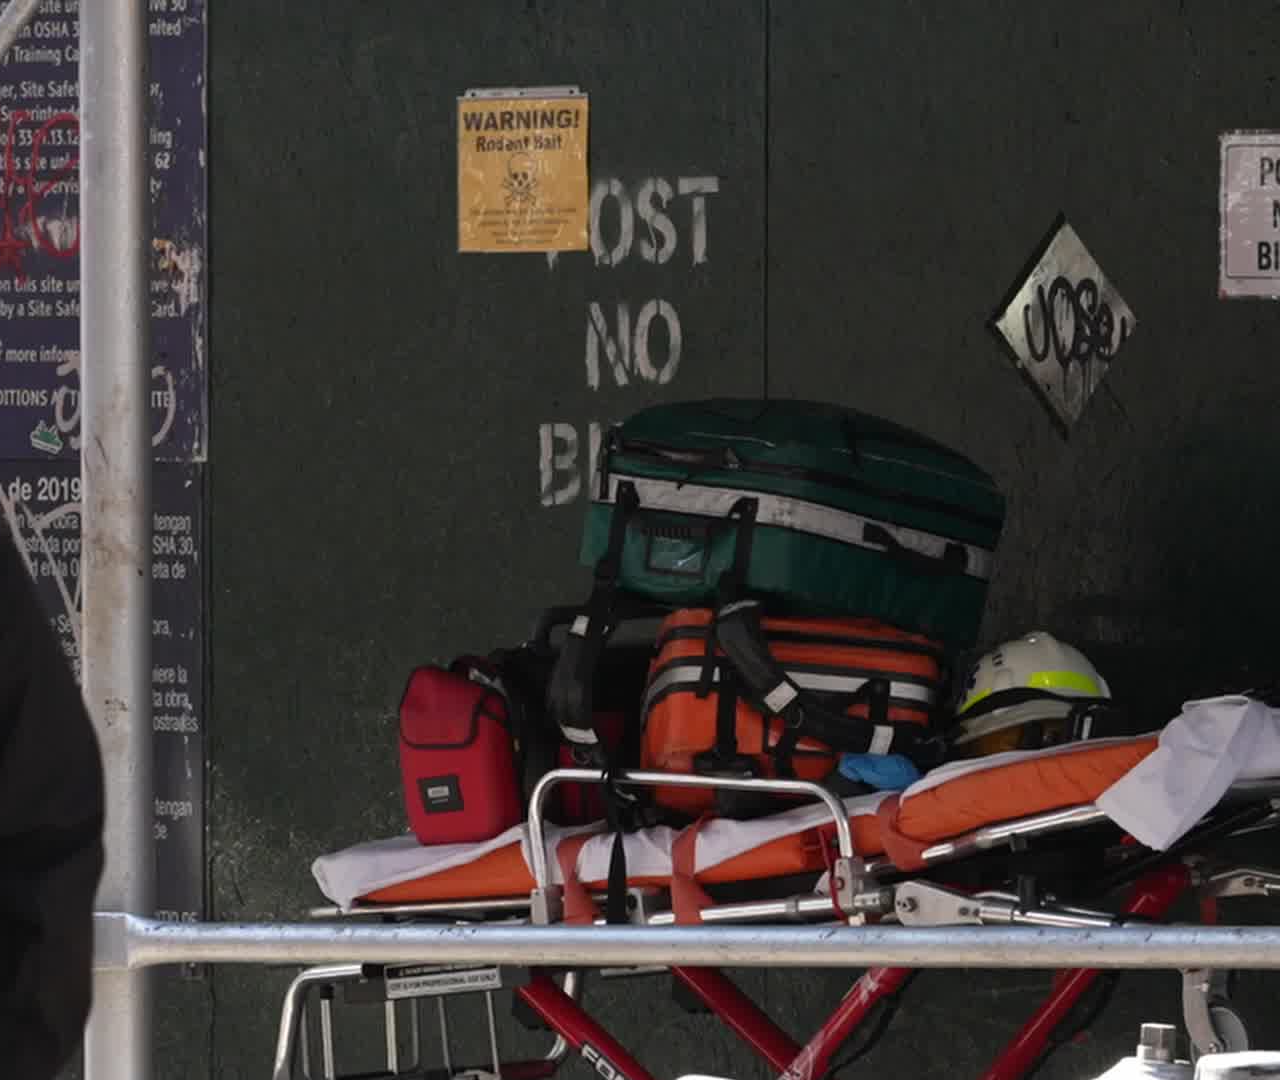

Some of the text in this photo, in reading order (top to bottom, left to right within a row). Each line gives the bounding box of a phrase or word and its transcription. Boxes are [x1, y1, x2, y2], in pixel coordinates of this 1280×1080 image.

[34, 20, 68, 38] OSHA
[14, 47, 61, 66] Training
[20, 80, 45, 97] Site
[48, 79, 80, 97] Safet
[463, 109, 580, 131] WARNING!
[476, 135, 530, 153] Rodent
[154, 153, 170, 169] 62
[588, 175, 720, 267] OST
[41, 275, 63, 293] site
[0, 299, 16, 321] by
[18, 304, 25, 317] a
[28, 299, 50, 317] Site
[585, 300, 683, 391] NO
[5, 350, 37, 362] more
[150, 390, 172, 408] ITE
[8, 477, 33, 500] de
[152, 536, 177, 554] SHA
